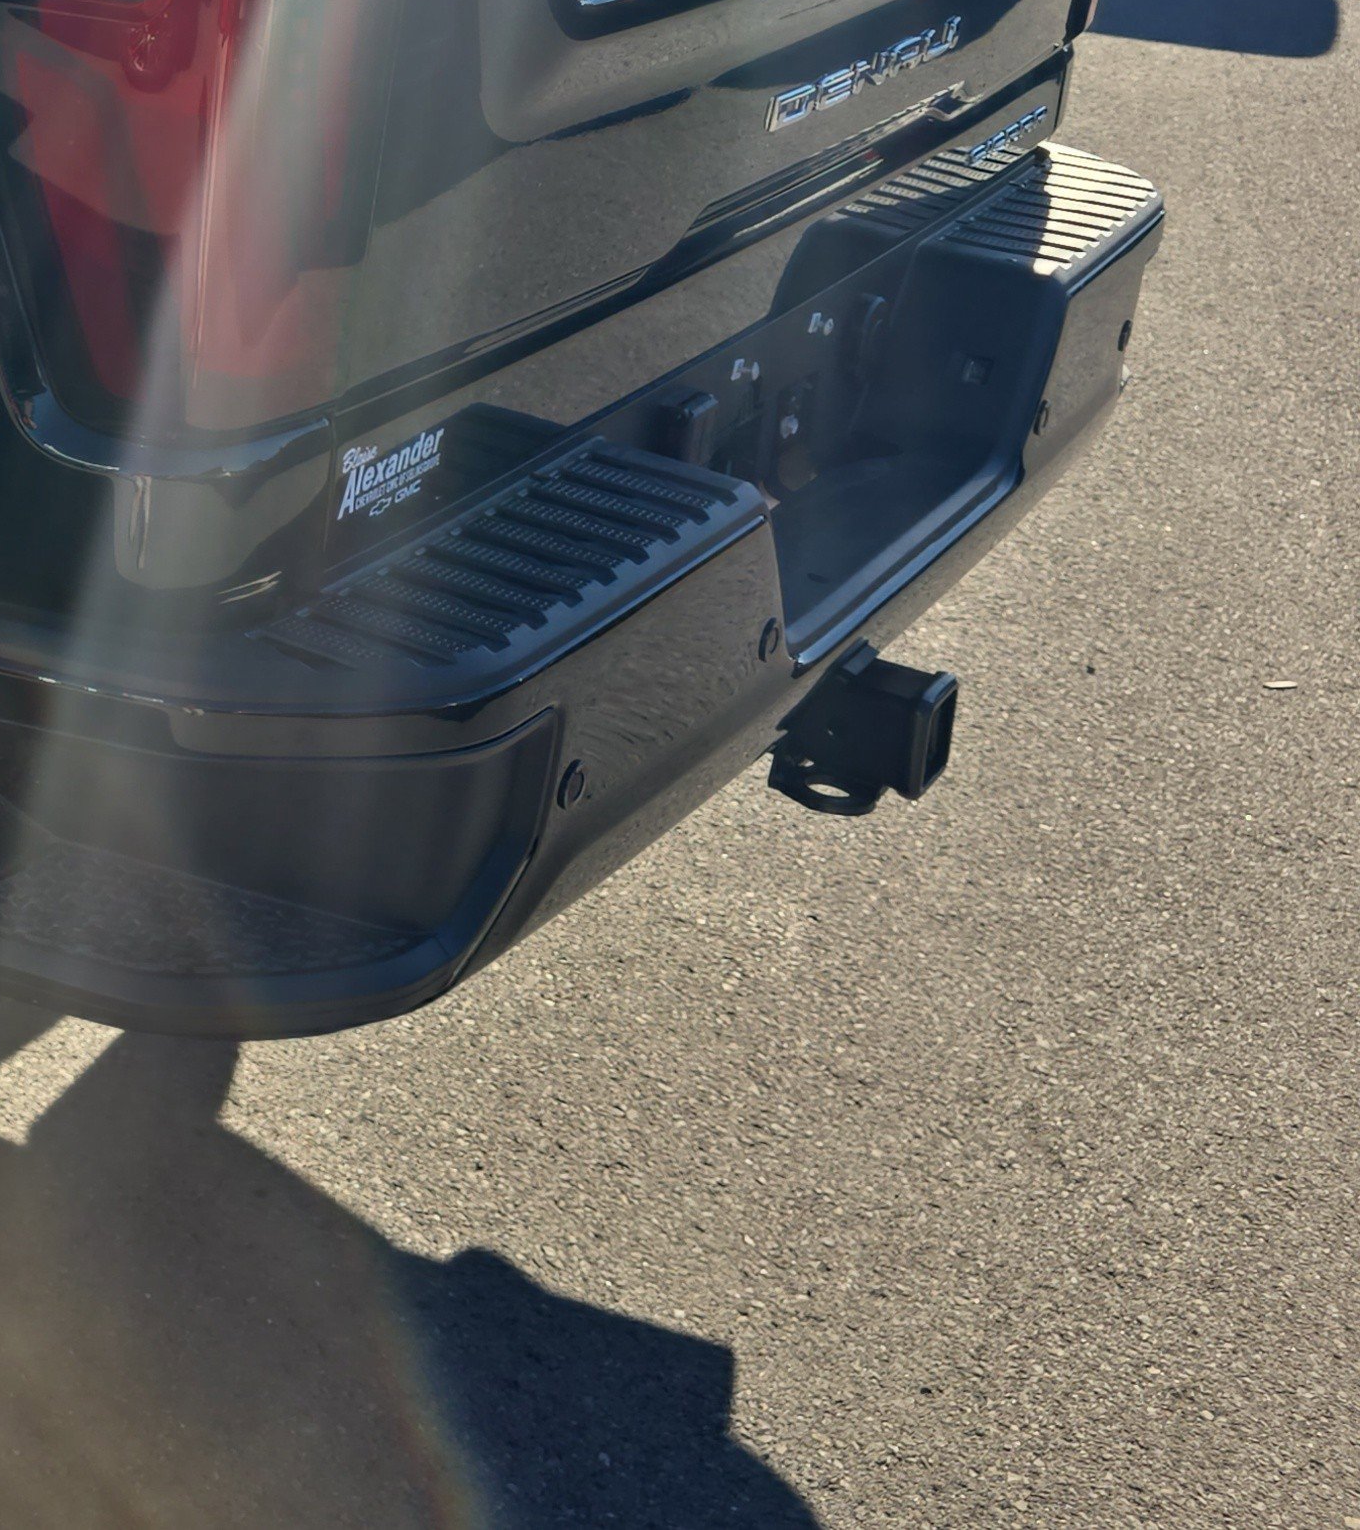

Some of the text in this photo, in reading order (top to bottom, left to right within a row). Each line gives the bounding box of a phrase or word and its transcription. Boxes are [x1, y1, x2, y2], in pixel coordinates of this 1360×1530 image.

[764, 15, 962, 132] DENALI
[337, 428, 445, 520] Alexander
[395, 479, 422, 503] GMC
